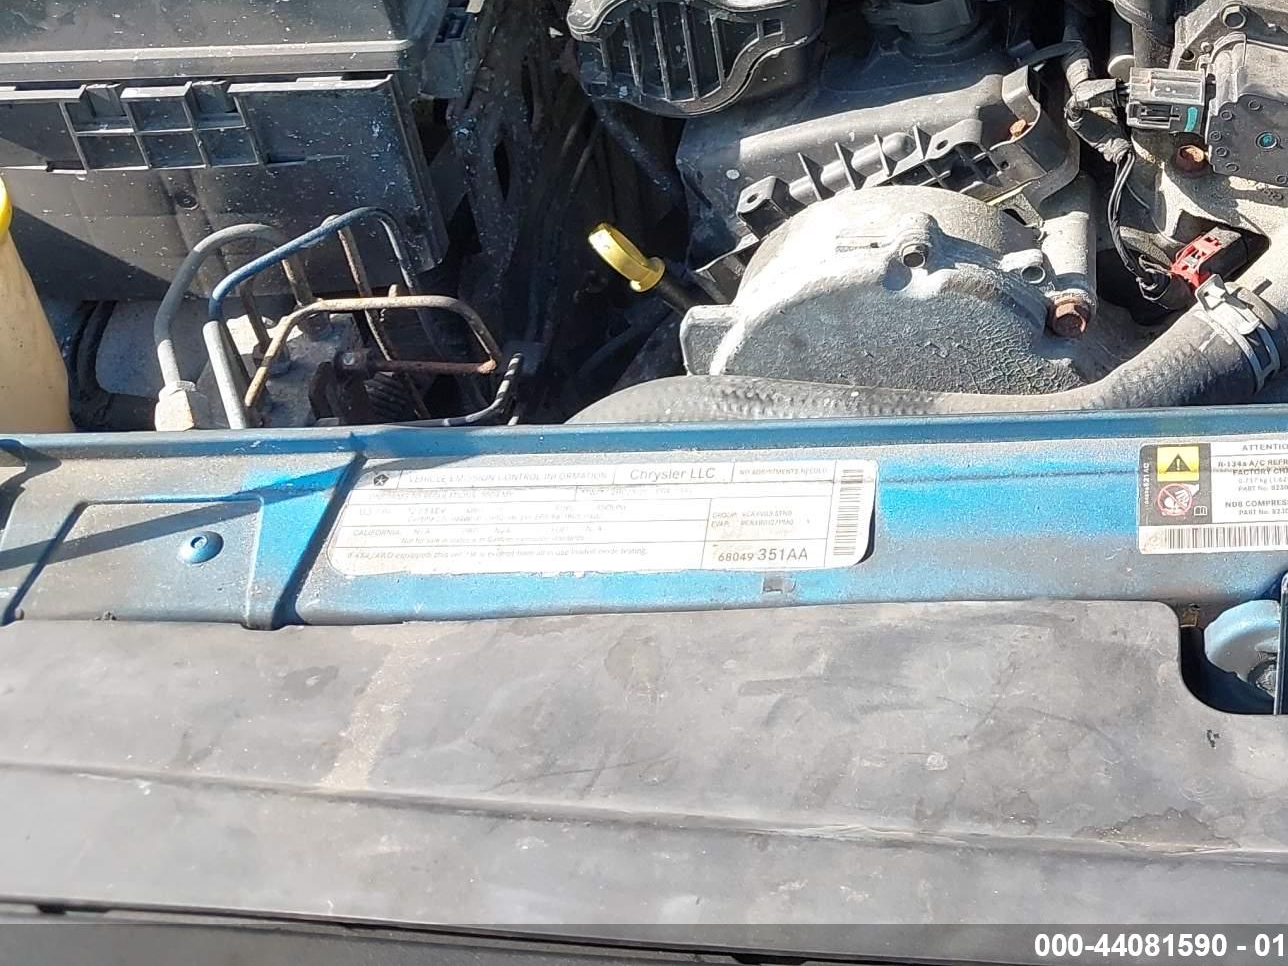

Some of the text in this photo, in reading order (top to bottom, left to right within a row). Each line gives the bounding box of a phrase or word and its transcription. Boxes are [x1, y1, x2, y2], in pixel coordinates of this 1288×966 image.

[1217, 460, 1248, 468] R-134a
[1249, 459, 1266, 468] A/C
[630, 467, 716, 483] Chrysler LLC
[1232, 468, 1271, 476] FACTORY
[1239, 508, 1257, 516] PART
[718, 547, 809, 562] 68049 351AA
